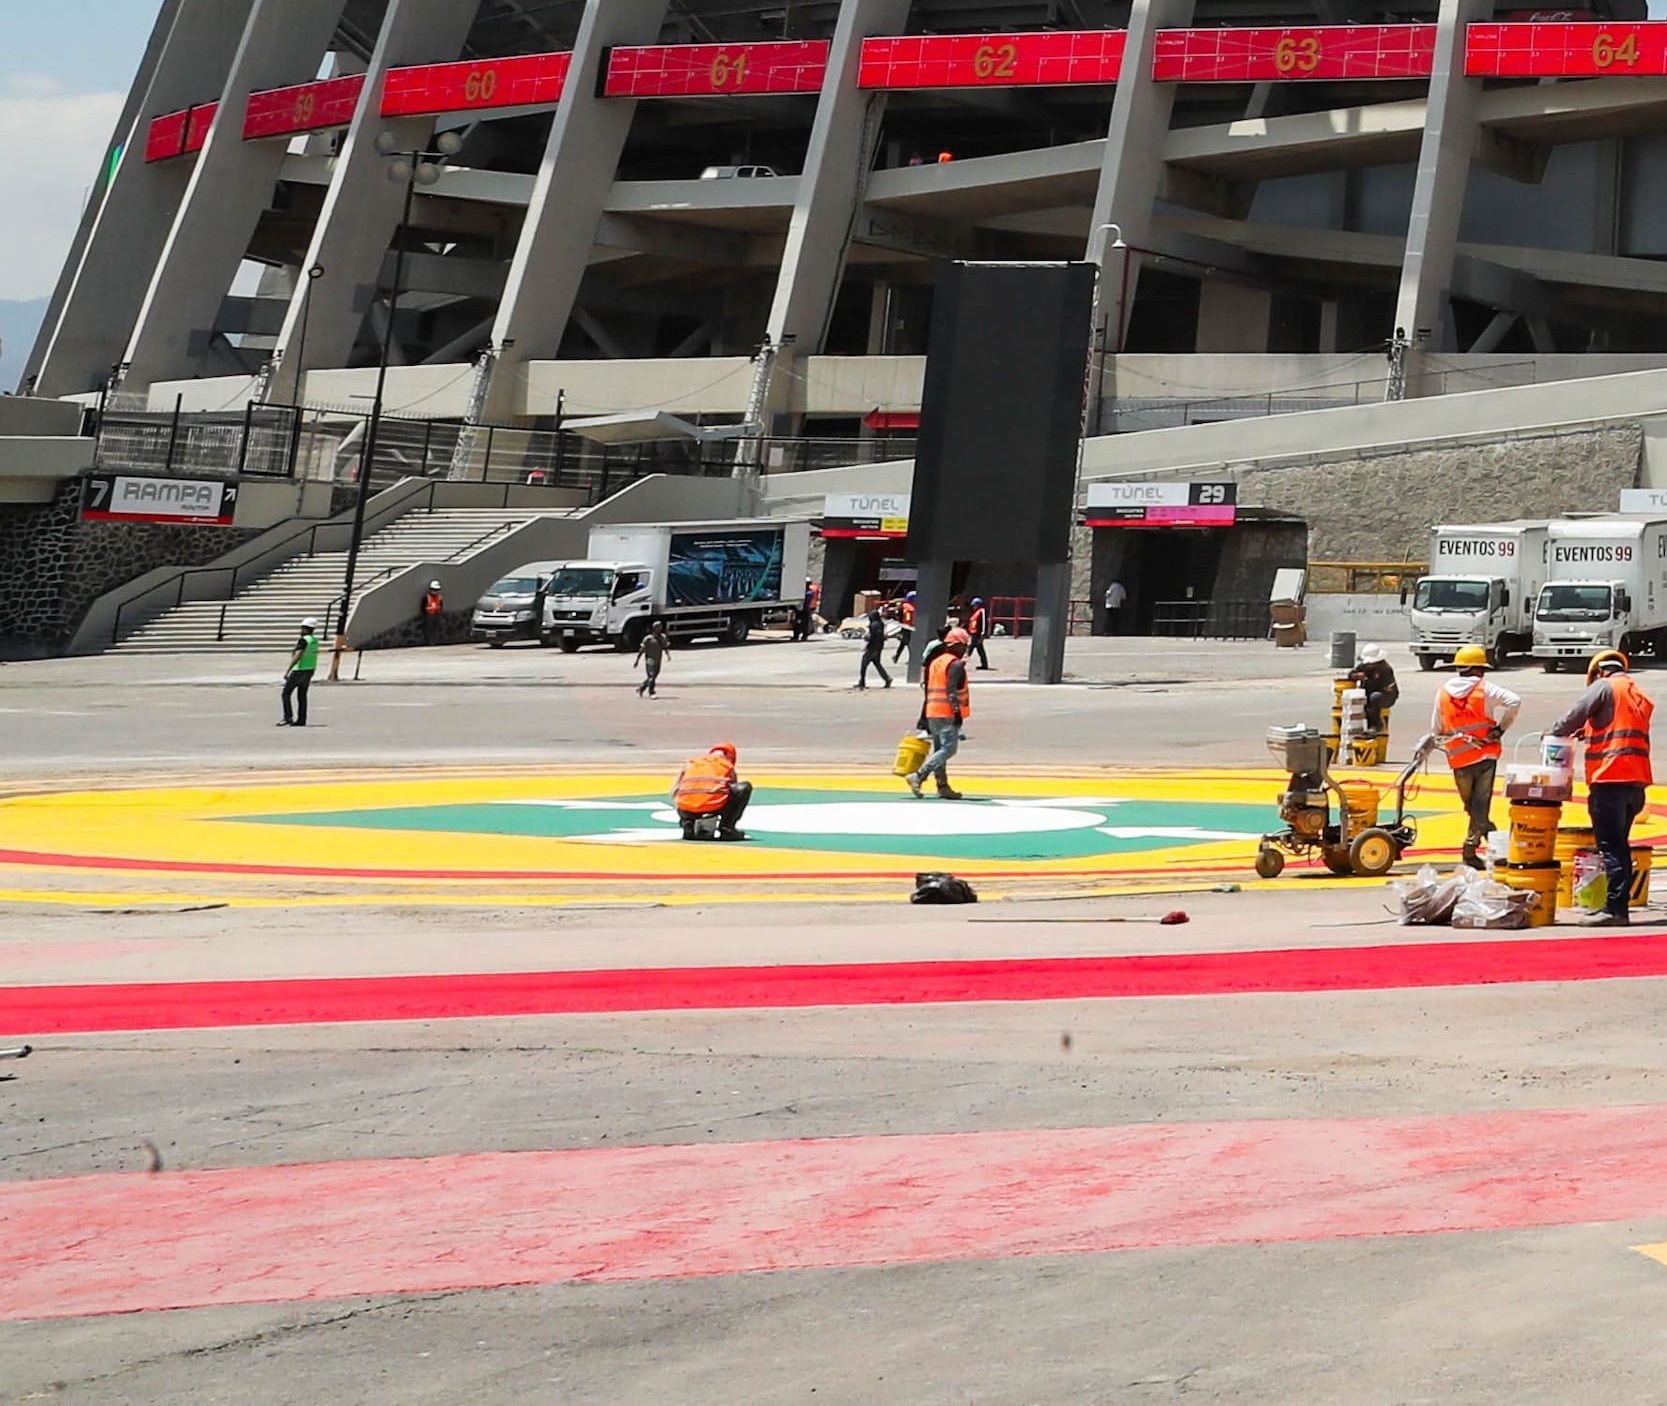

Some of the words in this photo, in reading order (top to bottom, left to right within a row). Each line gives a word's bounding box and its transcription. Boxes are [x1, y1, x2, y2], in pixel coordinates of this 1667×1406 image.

[974, 44, 1017, 78] 62
[1275, 38, 1320, 72] 63
[1592, 33, 1639, 68] 64
[709, 53, 748, 87] 61
[464, 69, 497, 102] 60
[90, 480, 110, 507] 7
[123, 481, 212, 503] RAMPA
[1112, 484, 1164, 499] TÚNEL
[1198, 485, 1225, 504] 29
[1439, 540, 1496, 556] EVENTOS
[1498, 541, 1515, 557] 99
[1555, 546, 1613, 562] EVENTOS
[1615, 546, 1632, 562] 99
